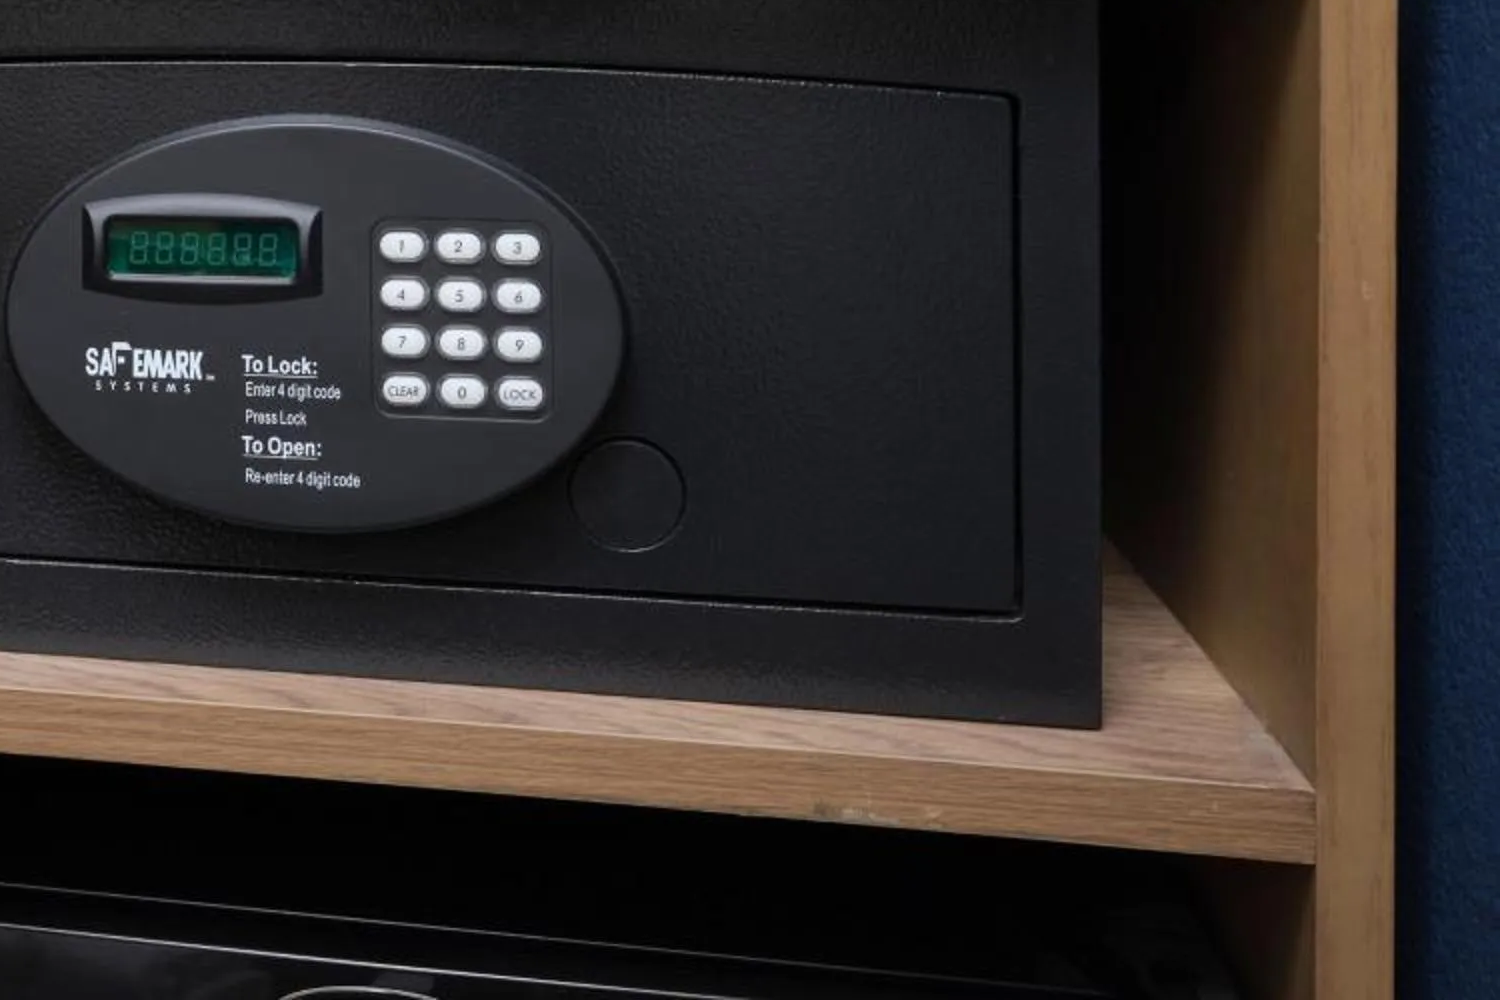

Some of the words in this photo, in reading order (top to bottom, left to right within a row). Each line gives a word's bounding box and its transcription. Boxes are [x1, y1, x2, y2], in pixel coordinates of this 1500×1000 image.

[454, 239, 463, 253] 2
[512, 241, 522, 254] 3
[397, 290, 405, 301] 4
[455, 290, 464, 303] 5
[514, 289, 523, 303] 6
[398, 335, 407, 348] 7
[457, 337, 465, 351] 8
[516, 340, 524, 352] 9
[85, 341, 203, 380] SAFEMARK
[241, 354, 264, 374] To
[267, 355, 318, 375] Lock:
[95, 379, 192, 394] SYSTEMS
[245, 381, 276, 397] Enter
[277, 383, 285, 396] 4
[287, 382, 312, 402] digit
[313, 384, 341, 400] code
[387, 386, 419, 397] CLEAR
[504, 390, 537, 401] LOCK
[245, 408, 278, 424] Press
[279, 409, 307, 426] Lock
[241, 435, 264, 454] To
[267, 436, 322, 459] Open:
[245, 467, 295, 485] Re-enter
[296, 471, 303, 484] 4
[305, 471, 331, 490] digit
[332, 472, 361, 488] code
